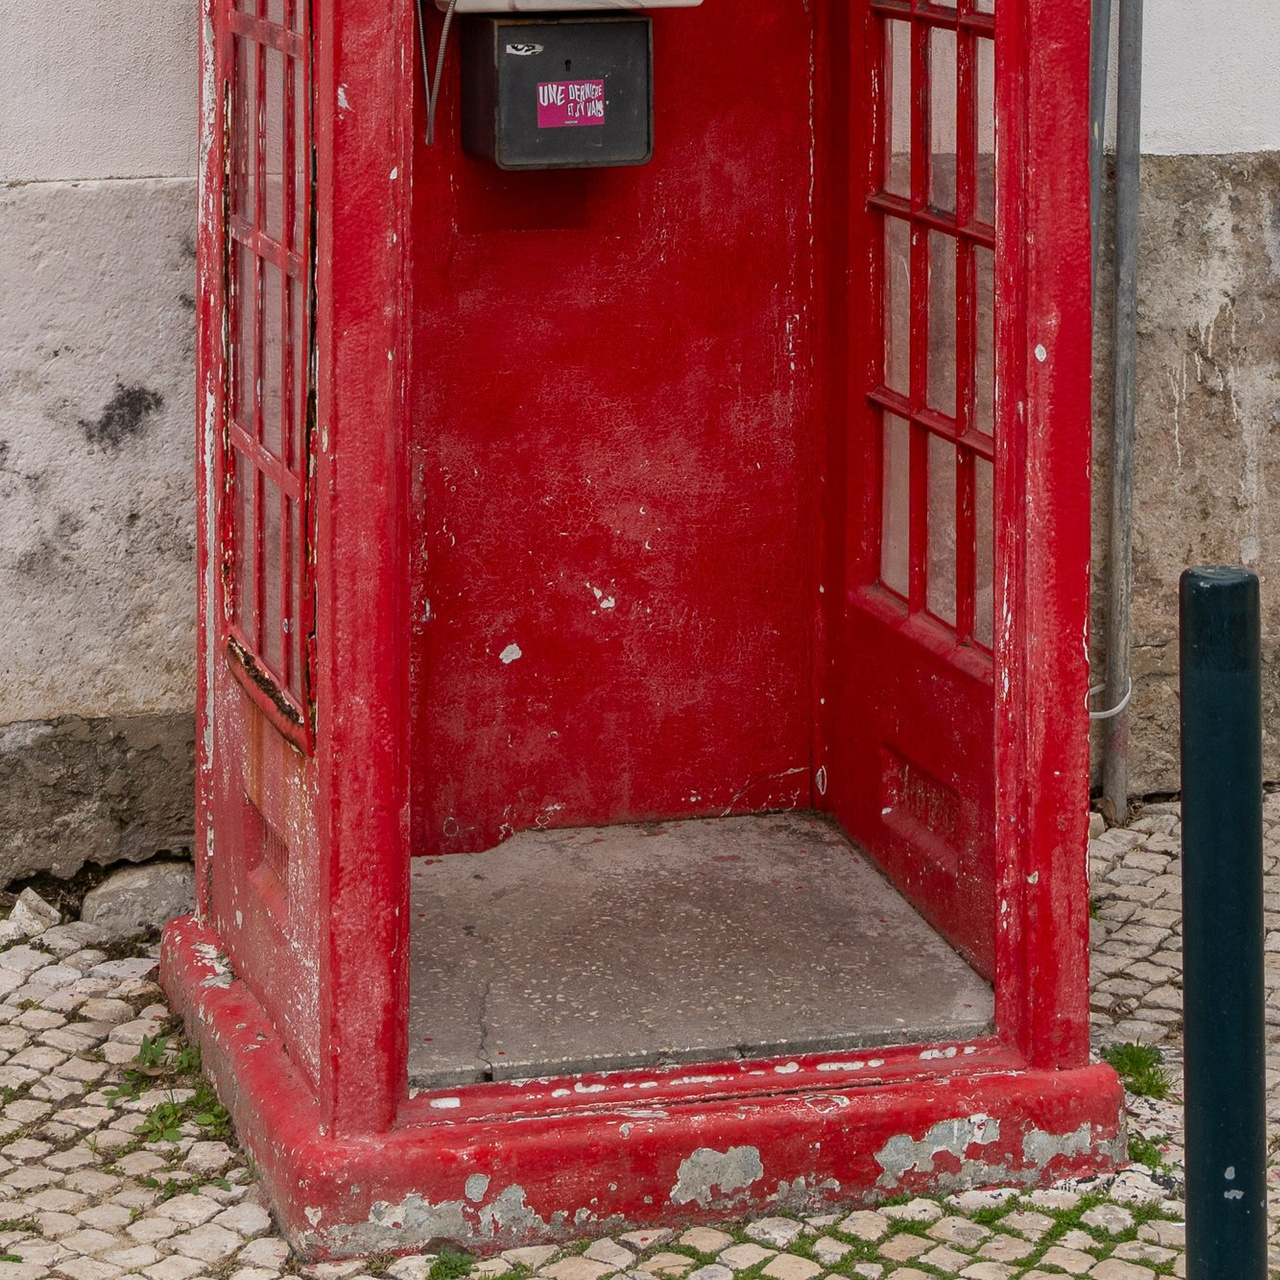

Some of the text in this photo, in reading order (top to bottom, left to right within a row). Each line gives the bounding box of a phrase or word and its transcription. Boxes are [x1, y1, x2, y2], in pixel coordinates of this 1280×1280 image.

[538, 83, 566, 107] UNE
[567, 102, 574, 117] ET
[586, 100, 604, 118] VAIS
